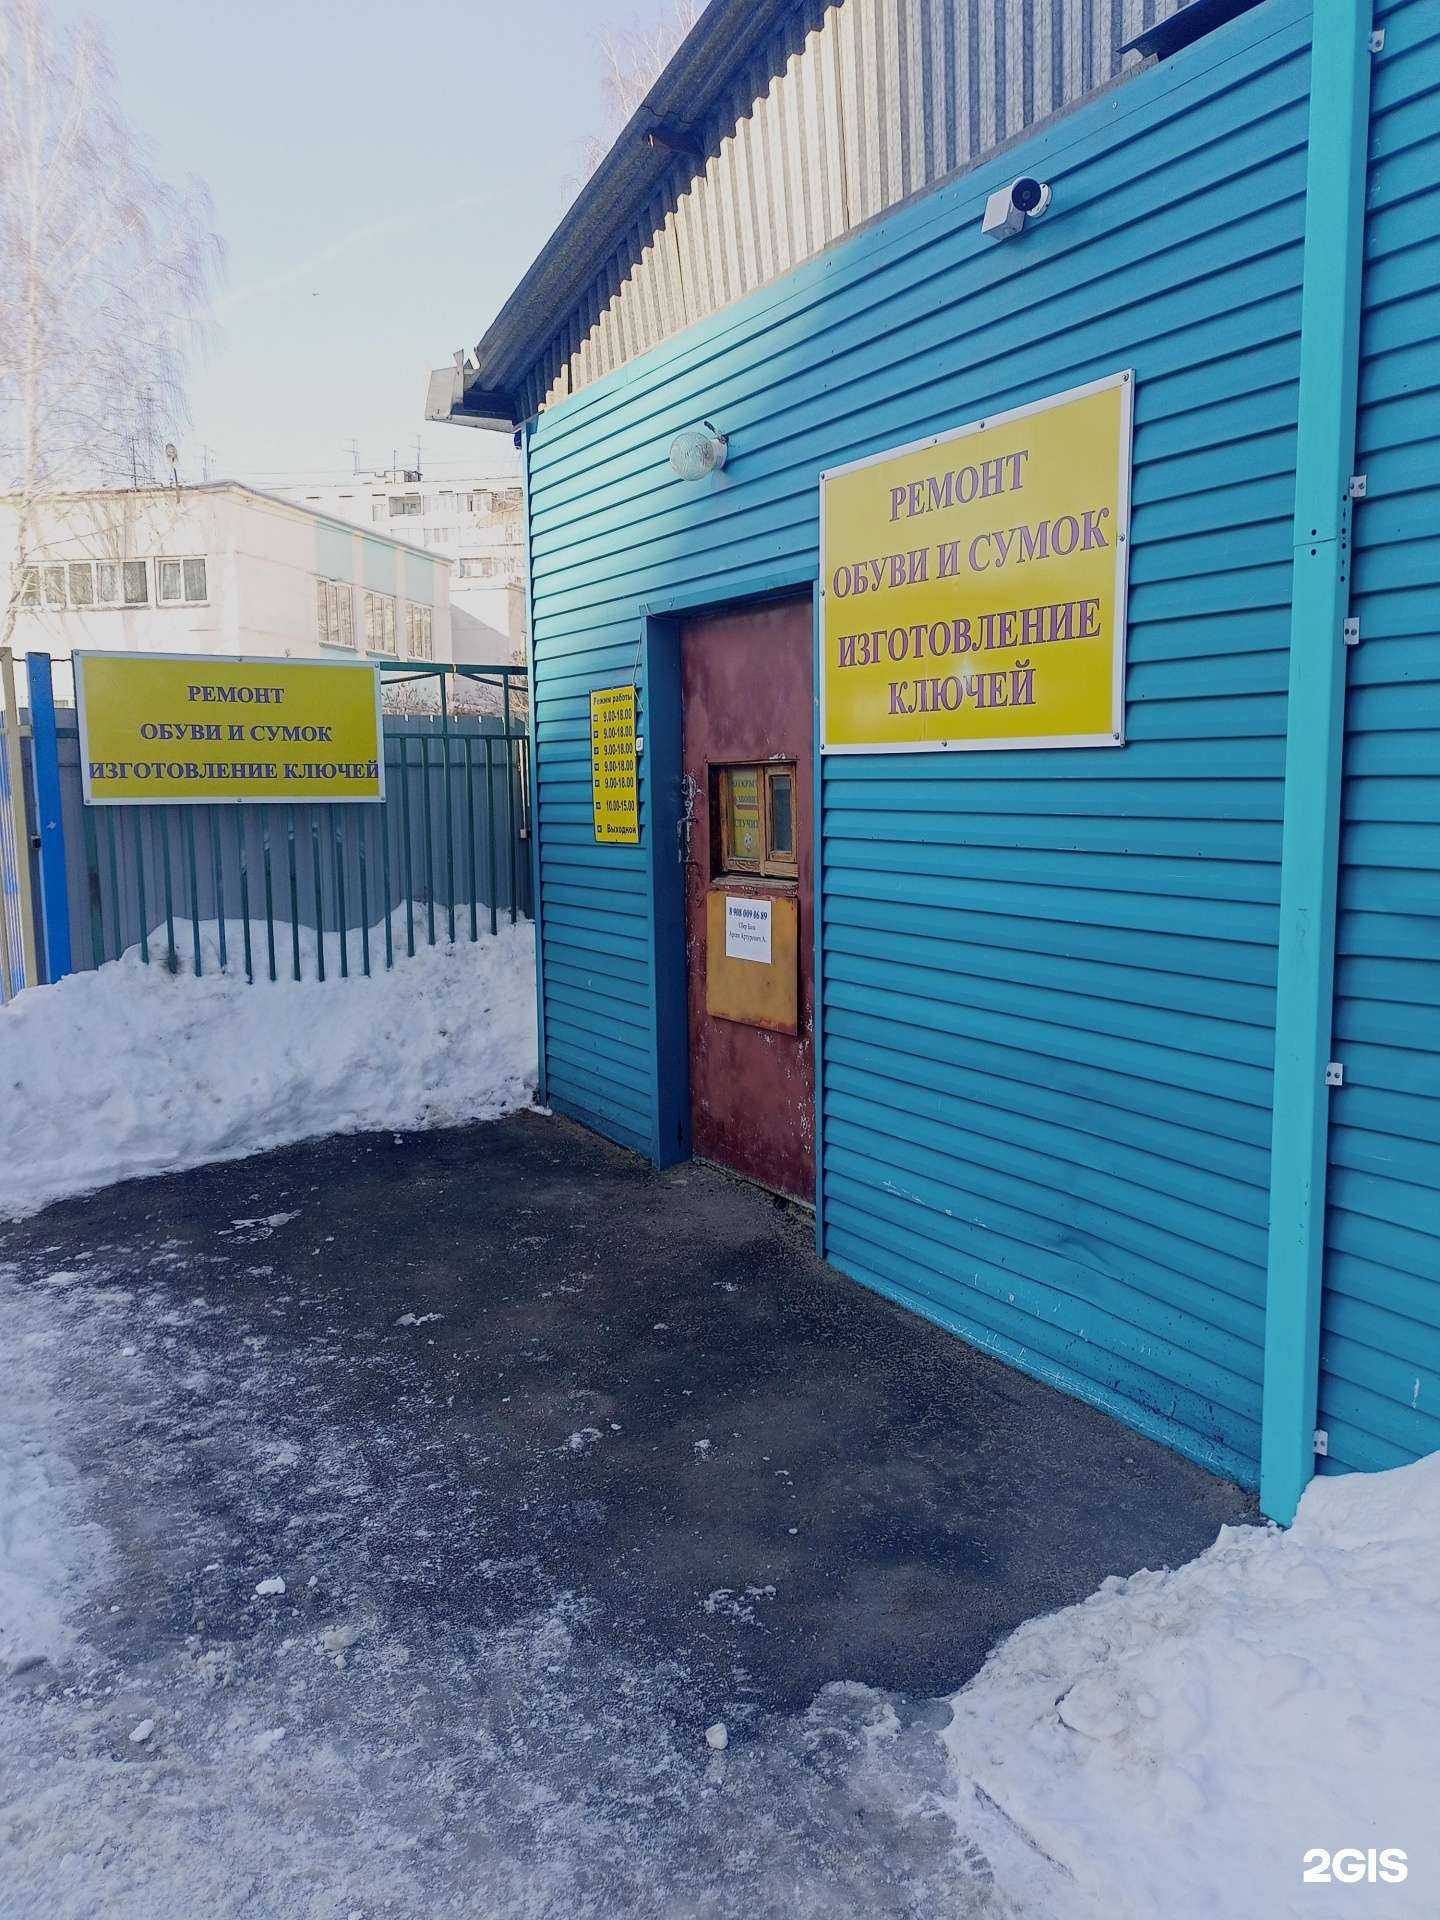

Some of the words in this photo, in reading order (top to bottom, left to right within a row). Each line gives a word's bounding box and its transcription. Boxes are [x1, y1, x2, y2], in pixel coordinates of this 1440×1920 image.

[889, 450, 1029, 522] РЕМОНТ
[832, 547, 929, 599] ОБУВИ
[936, 540, 961, 579] И
[968, 507, 1110, 572] СУМОК
[837, 598, 1101, 668] ИЗГОТОВЛЕНИЕ
[187, 685, 285, 704] РЕМОНТ
[888, 659, 1036, 715] КЛЮЧЕЙ
[613, 693, 632, 704] работы
[603, 708, 632, 722] 9.00-18.00
[140, 723, 221, 741] ОБУВИ
[228, 724, 244, 741] И
[249, 725, 332, 743] СУМОК
[604, 725, 632, 738] 9.00-18.00
[604, 743, 633, 755] 9.00-18.00
[89, 762, 278, 779] ИЗГОТОВЛЕНИЕ
[284, 759, 379, 779] КЛЮЧЕЙ
[604, 760, 633, 772] 9.00-18.00
[605, 777, 633, 788] 9.00-18.00
[607, 824, 636, 835] Выходной
